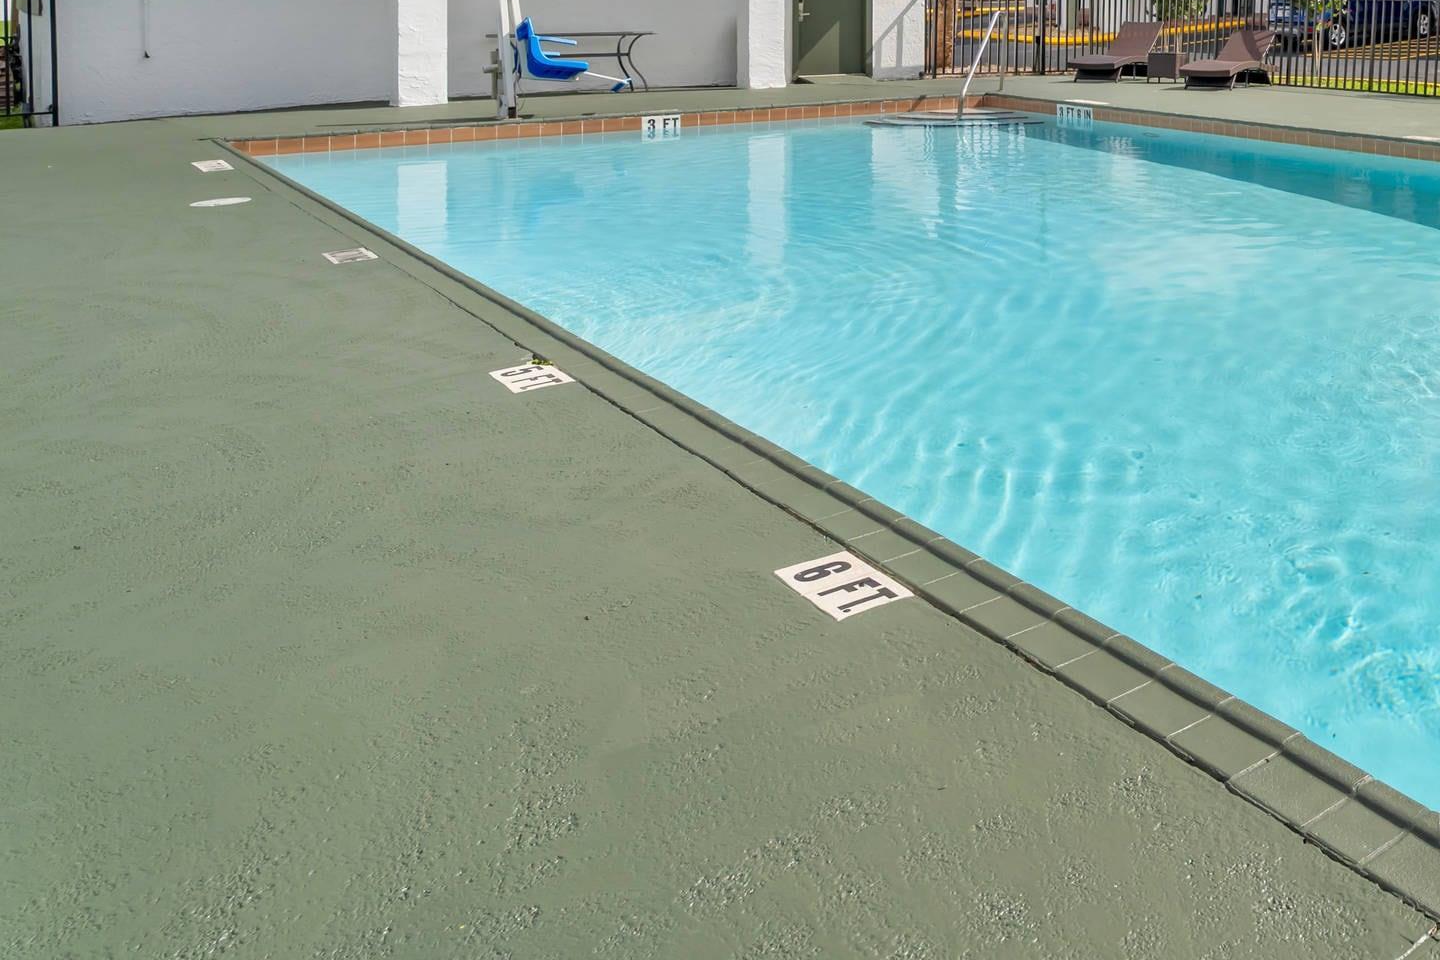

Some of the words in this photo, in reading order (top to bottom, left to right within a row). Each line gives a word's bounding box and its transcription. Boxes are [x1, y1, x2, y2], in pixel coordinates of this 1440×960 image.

[1066, 106, 1075, 119] FT
[647, 118, 656, 131] 3
[663, 117, 679, 129] FT
[500, 366, 544, 377] 5
[793, 560, 852, 583] 6
